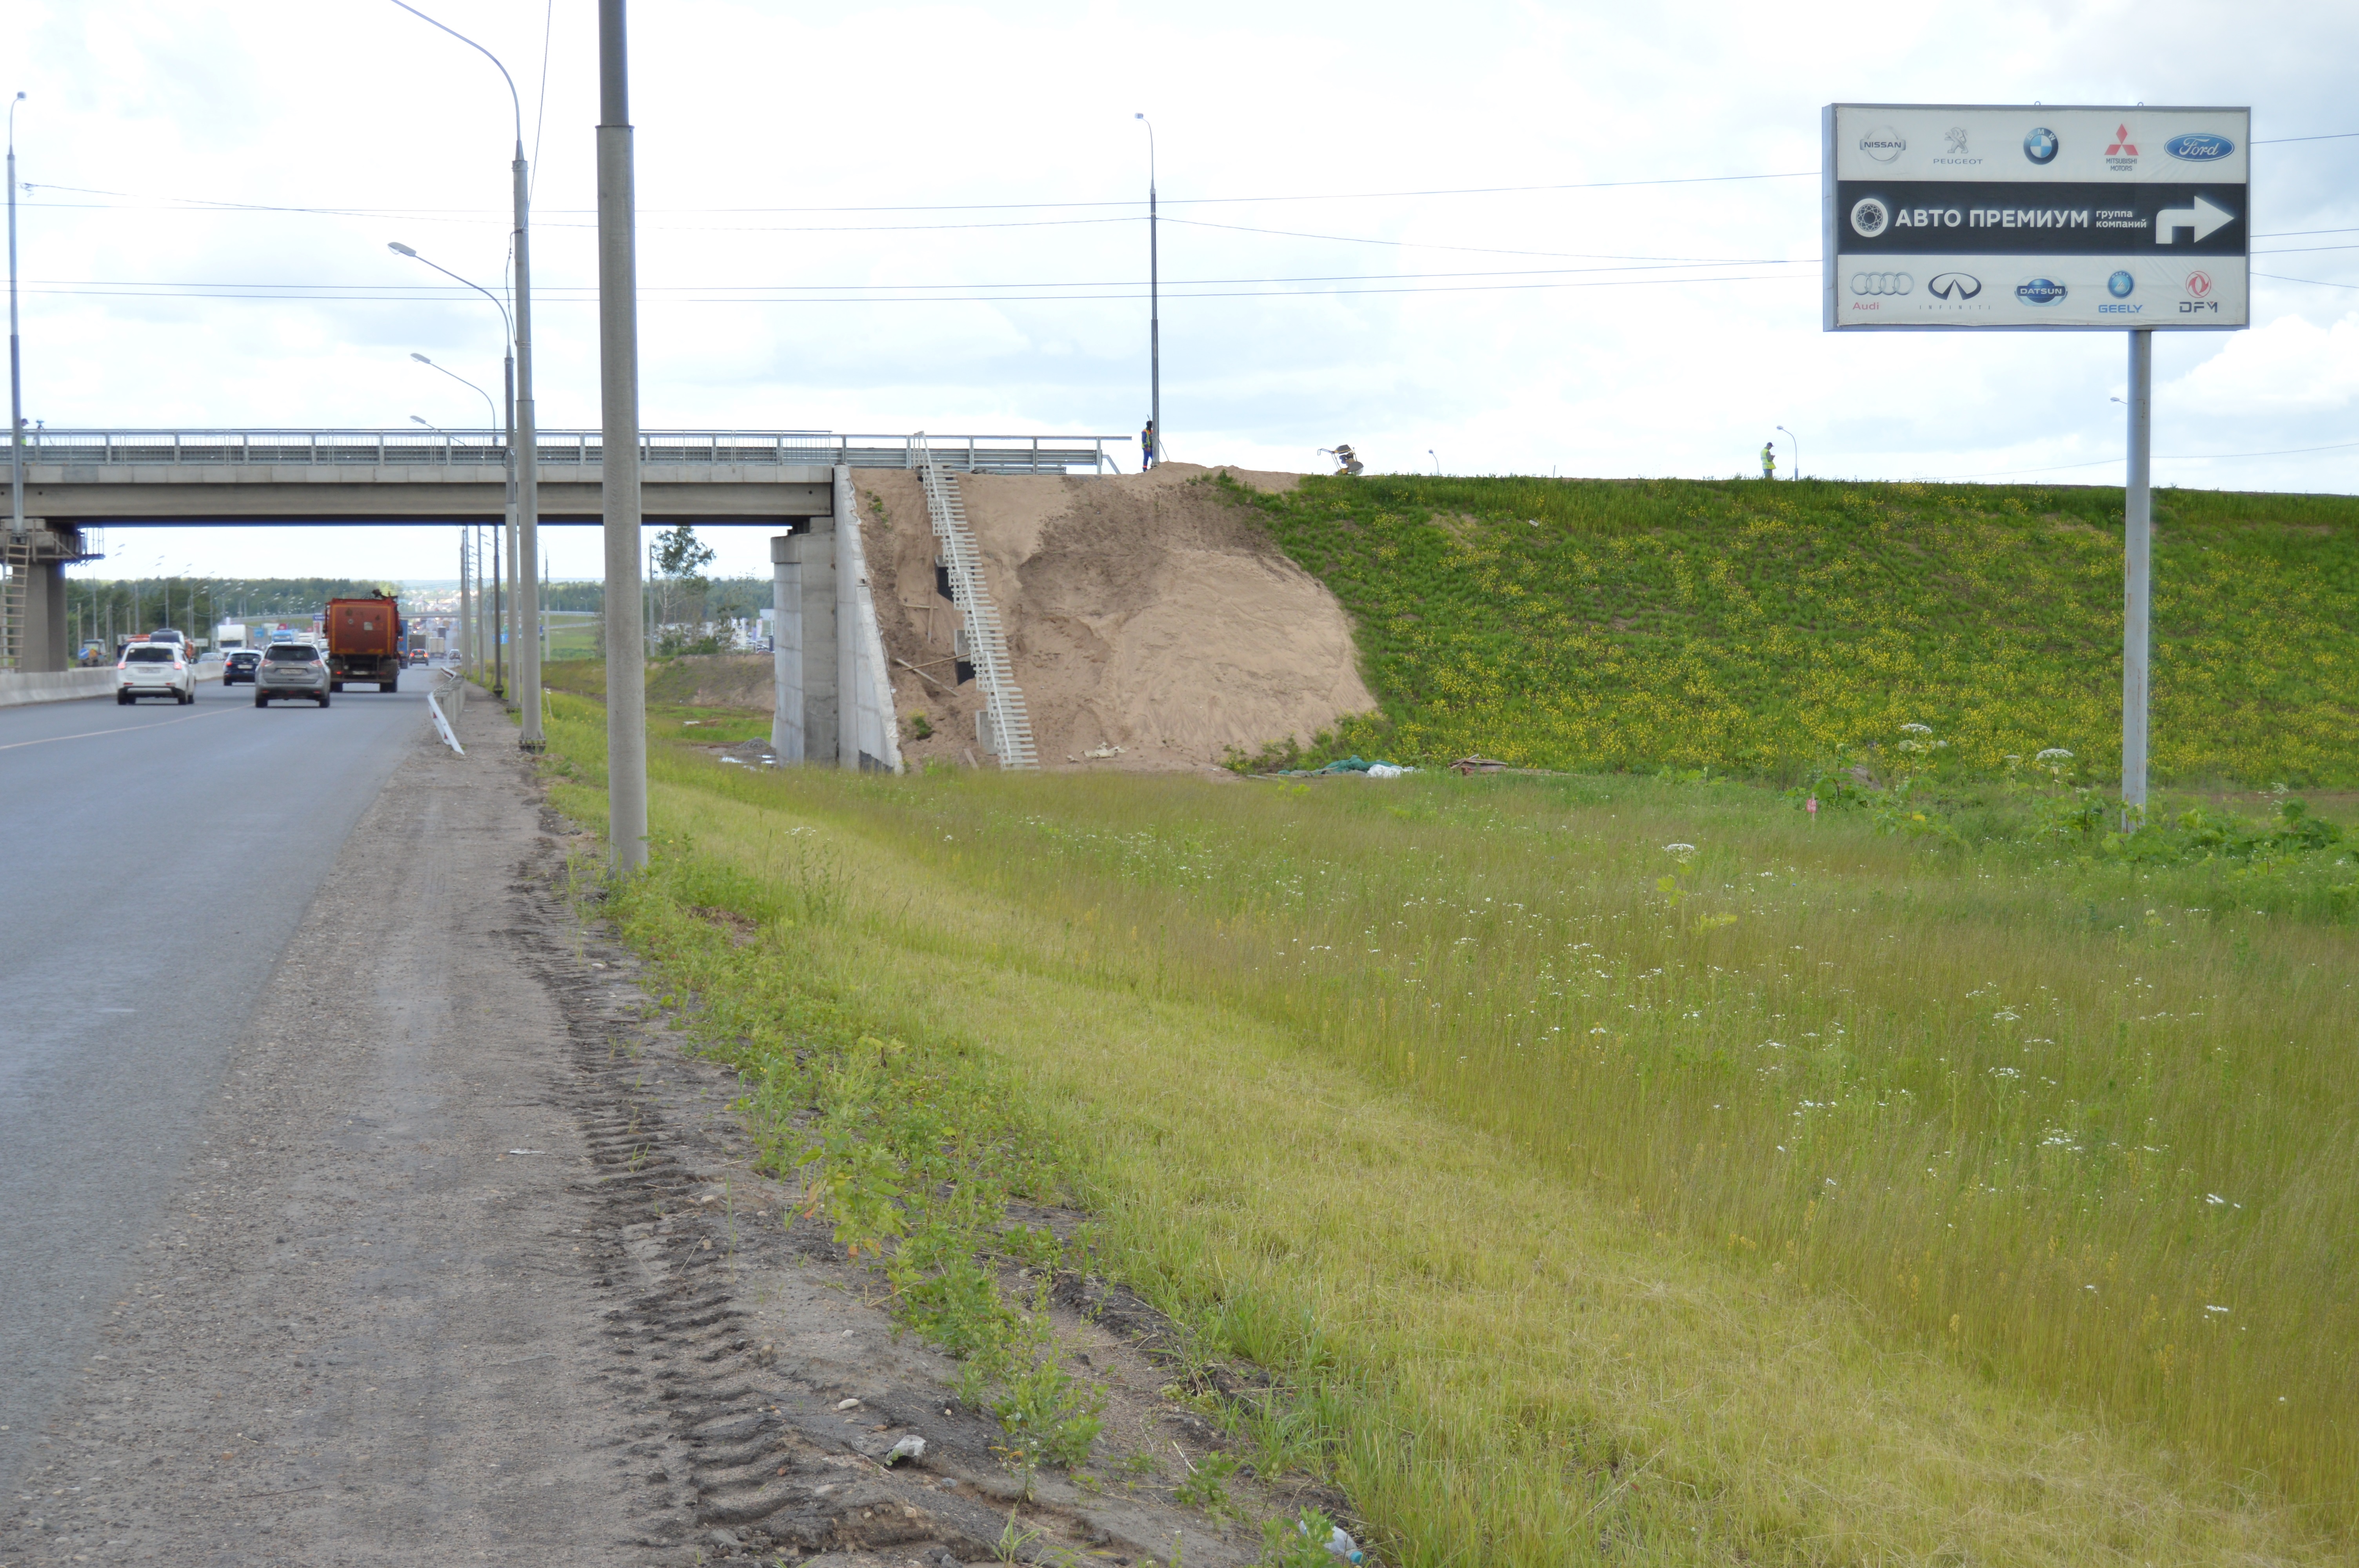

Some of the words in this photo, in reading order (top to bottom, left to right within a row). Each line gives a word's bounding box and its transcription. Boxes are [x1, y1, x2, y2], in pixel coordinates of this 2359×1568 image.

[2026, 128, 2056, 140] BMW
[2179, 138, 2220, 155] Ford
[1895, 209, 1961, 227] АВТО
[1970, 210, 2088, 228] ПРЕМИУМ
[2096, 211, 2133, 219] группа
[2096, 219, 2147, 228] компаний
[1852, 302, 1879, 310] Audi
[2098, 304, 2143, 313] GEELY
[2179, 301, 2218, 313] DFM
